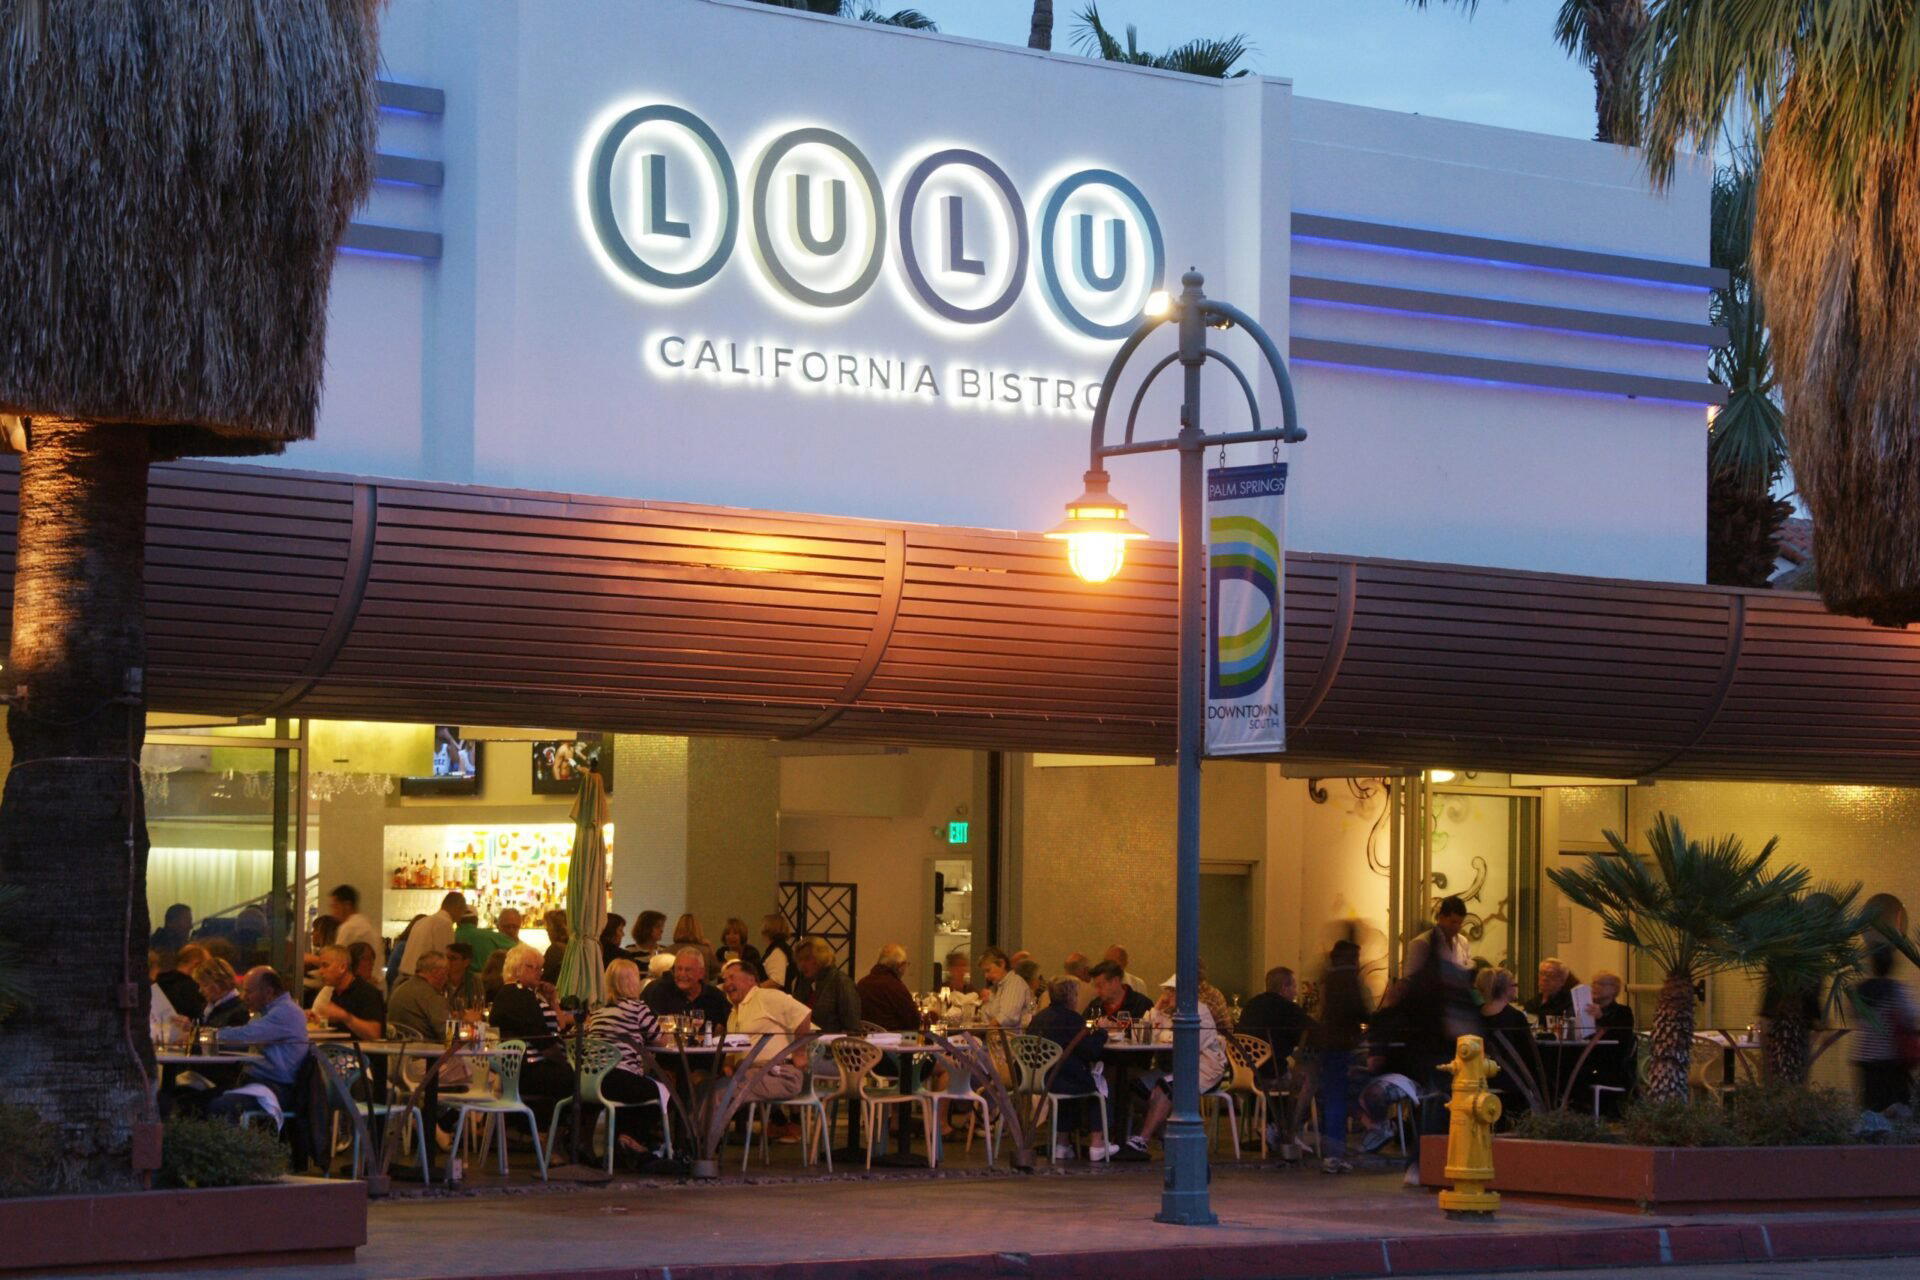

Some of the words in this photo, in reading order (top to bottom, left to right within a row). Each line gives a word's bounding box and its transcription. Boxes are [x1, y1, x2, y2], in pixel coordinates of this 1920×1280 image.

[659, 335, 941, 396] CALIFORNIA
[1208, 483, 1237, 497] PALM
[1239, 478, 1285, 495] SPRINGS
[1208, 704, 1279, 719] DOWNTOWN
[1248, 718, 1280, 729] SOUTH
[949, 822, 968, 843] EXIT
